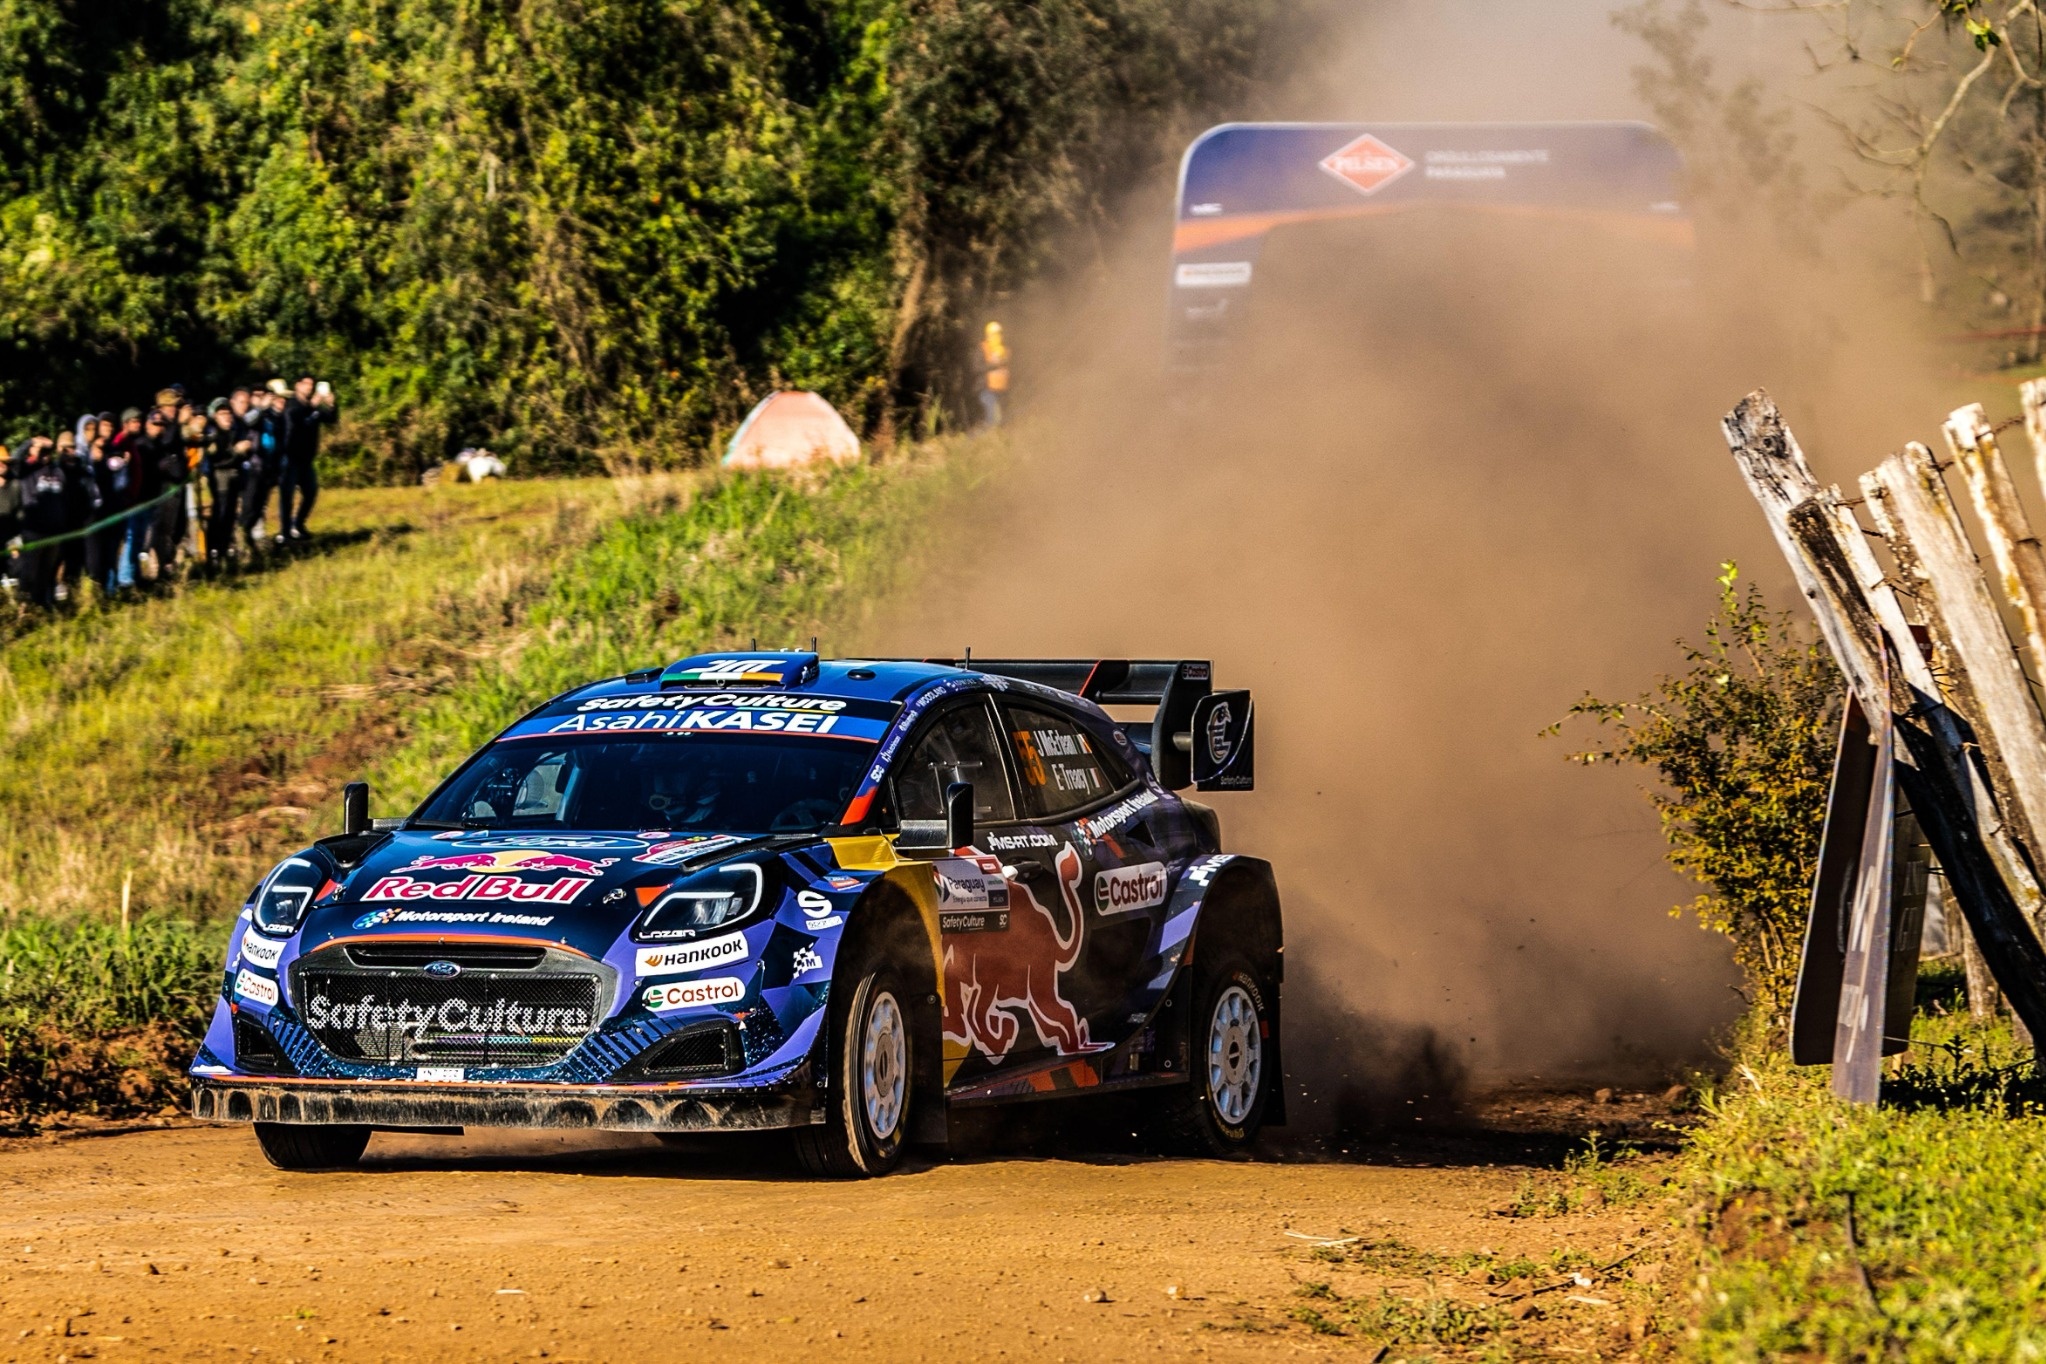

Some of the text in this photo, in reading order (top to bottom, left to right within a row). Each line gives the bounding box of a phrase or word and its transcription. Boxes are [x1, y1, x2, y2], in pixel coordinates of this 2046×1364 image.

[577, 693, 846, 713] SafetyCulture
[549, 712, 837, 733] AsahiKASEI
[1033, 730, 1045, 757] J
[1012, 731, 1047, 785] 55
[1051, 764, 1065, 790] E
[1087, 788, 1159, 839] Motorsport Ireland
[361, 875, 594, 904] Red Bull
[947, 876, 986, 892] Paraguay
[1109, 872, 1165, 907] Castrol
[396, 911, 554, 926] Motorsport Ireland
[942, 915, 985, 929] SafetyCulture
[243, 977, 275, 1002] Castrol
[666, 982, 740, 1004] Castrol
[307, 994, 588, 1041] SafetyCulture
